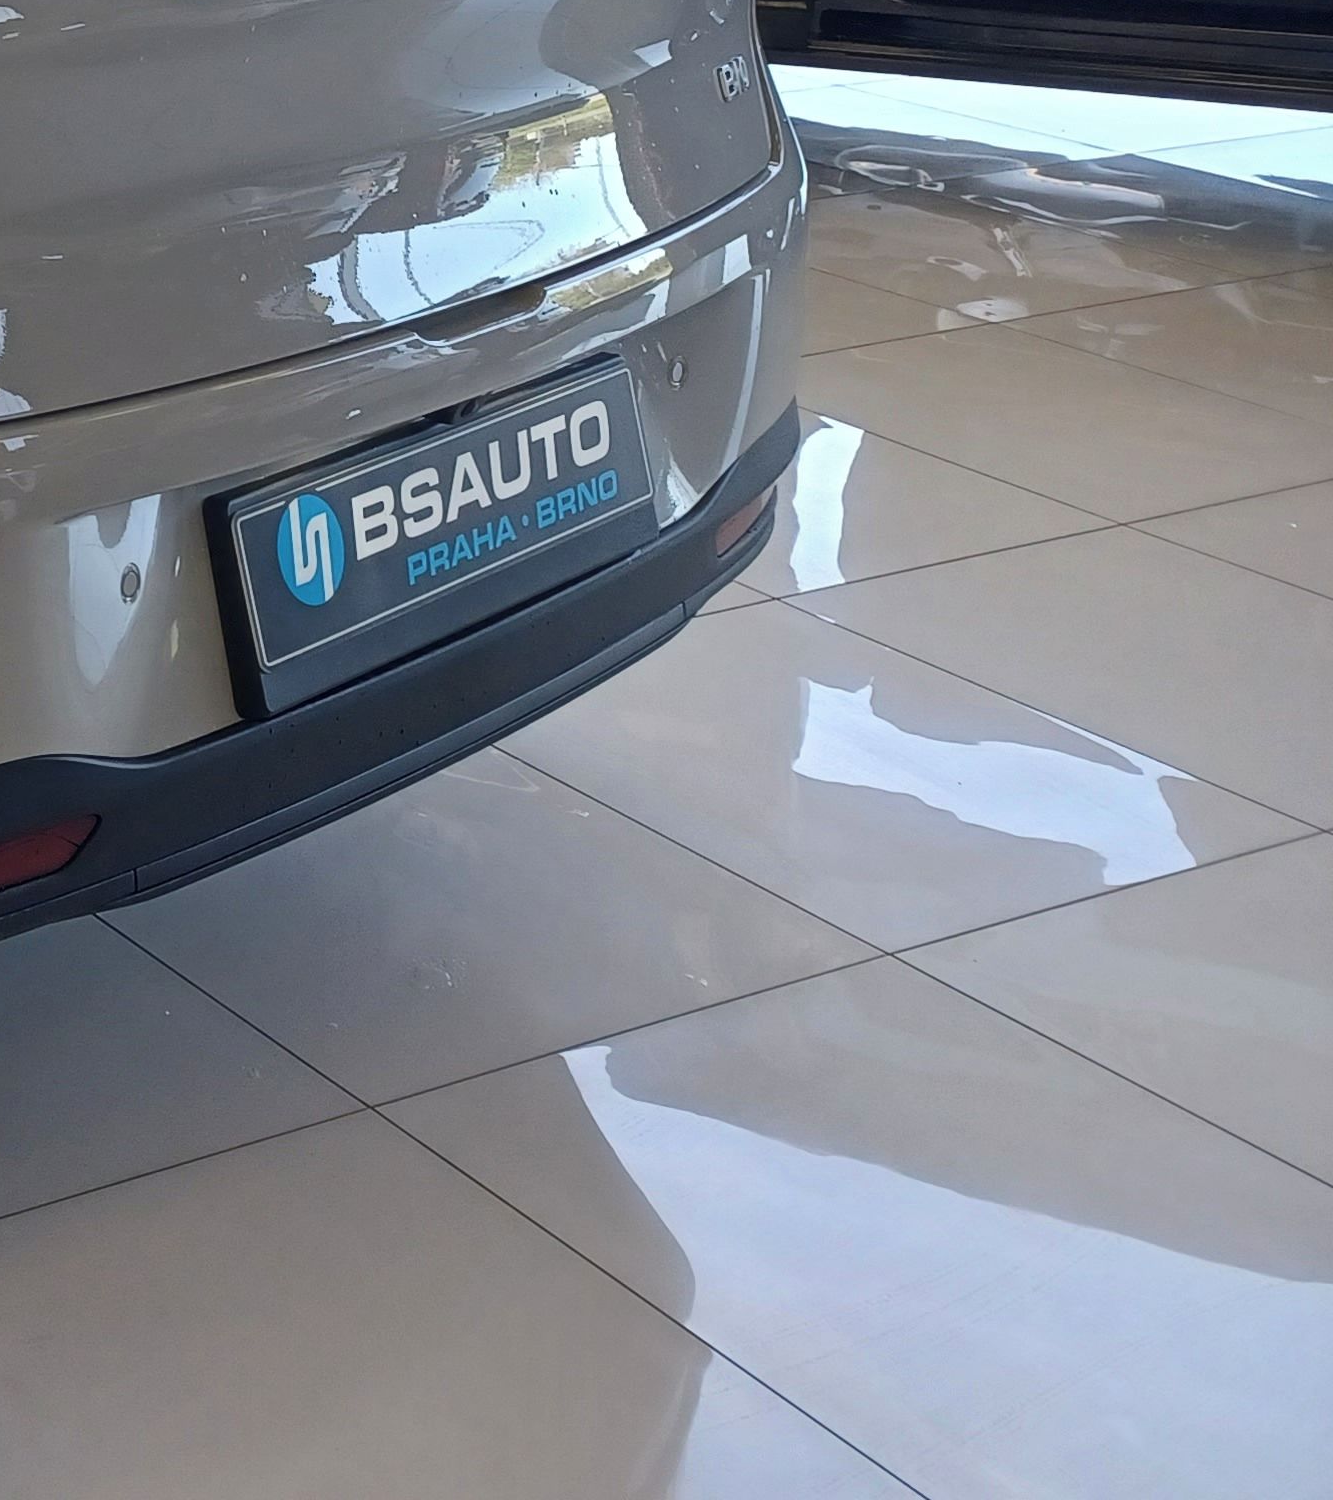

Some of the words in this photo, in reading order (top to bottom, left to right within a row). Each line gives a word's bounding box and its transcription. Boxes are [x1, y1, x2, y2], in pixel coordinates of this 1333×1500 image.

[350, 399, 612, 562] BSAUTO
[407, 520, 517, 586] PRAHA
[535, 469, 619, 532] BRNO
